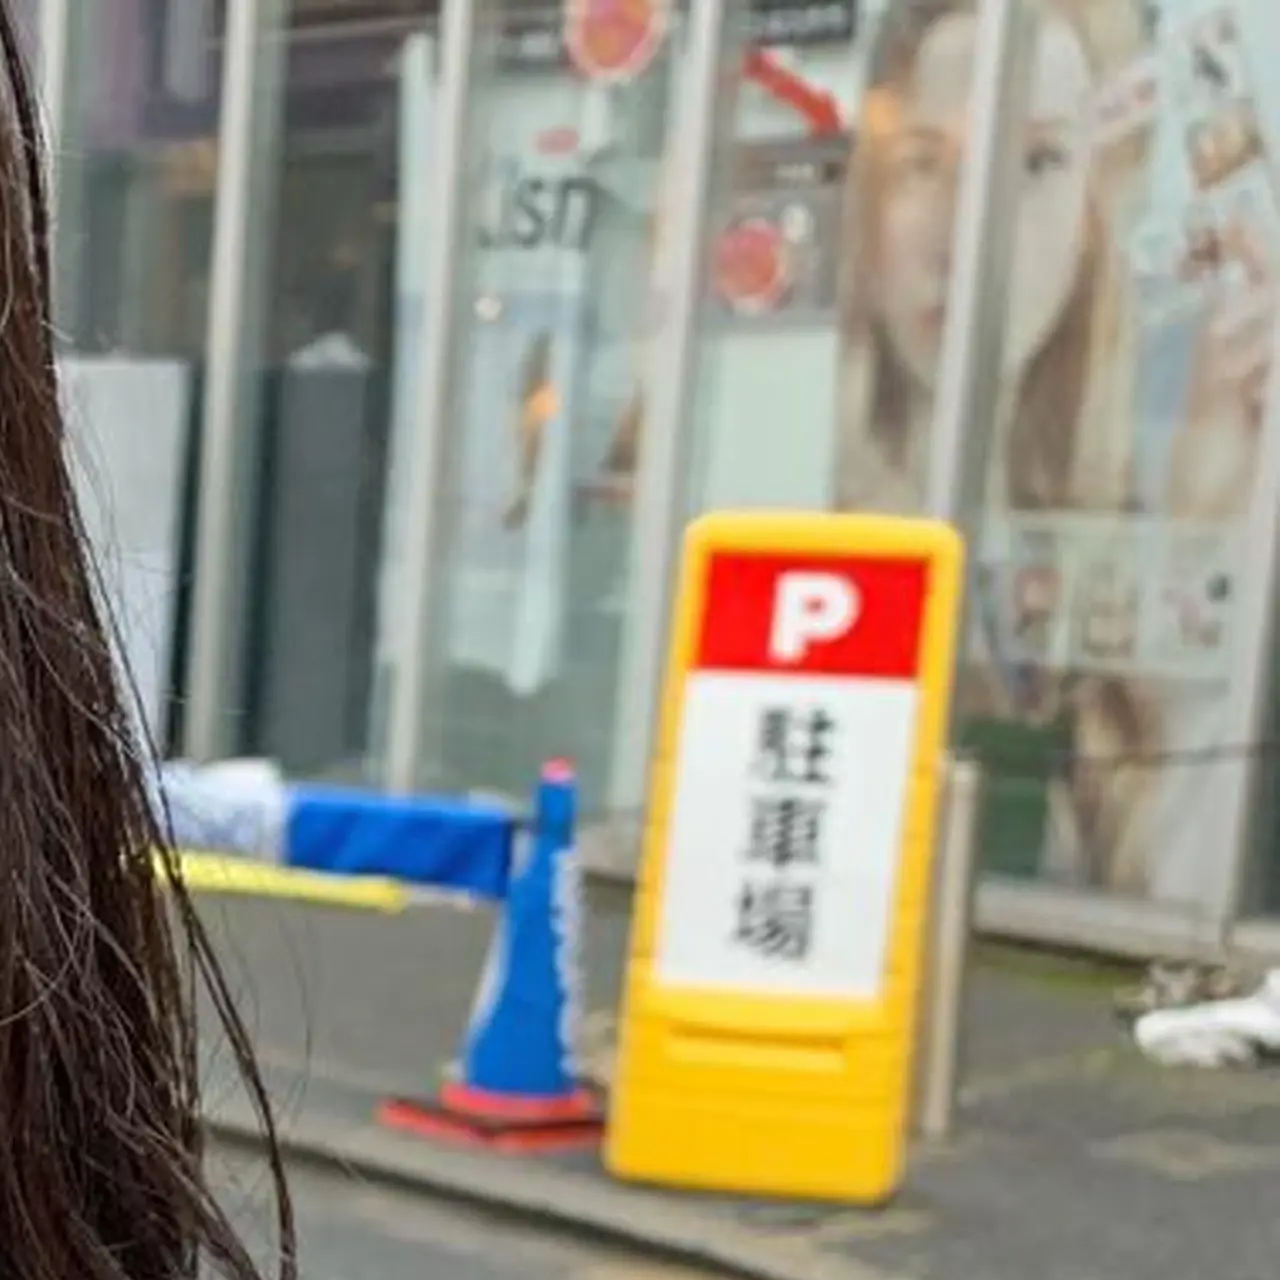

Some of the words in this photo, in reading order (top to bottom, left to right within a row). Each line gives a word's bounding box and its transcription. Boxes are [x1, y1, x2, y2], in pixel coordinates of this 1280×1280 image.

[768, 570, 861, 663] P
[733, 706, 836, 961] 駐車場
